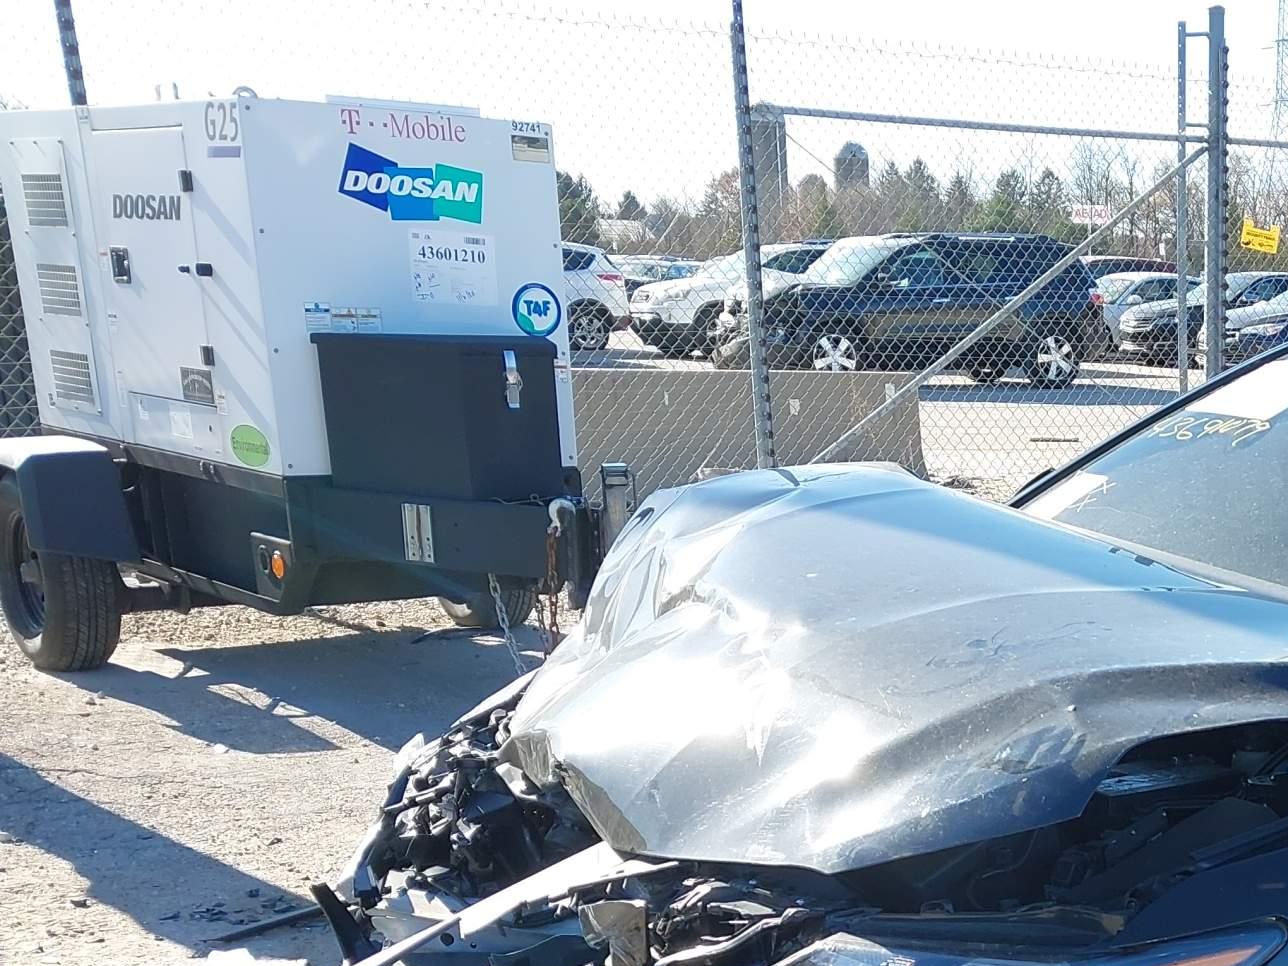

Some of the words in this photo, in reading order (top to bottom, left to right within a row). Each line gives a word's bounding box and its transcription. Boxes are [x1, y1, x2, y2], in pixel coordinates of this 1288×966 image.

[204, 101, 239, 142] G25
[511, 120, 542, 134] 92741
[342, 169, 479, 203] DOOSAN
[112, 193, 181, 221] DOOSAN
[417, 244, 486, 264] 43601210
